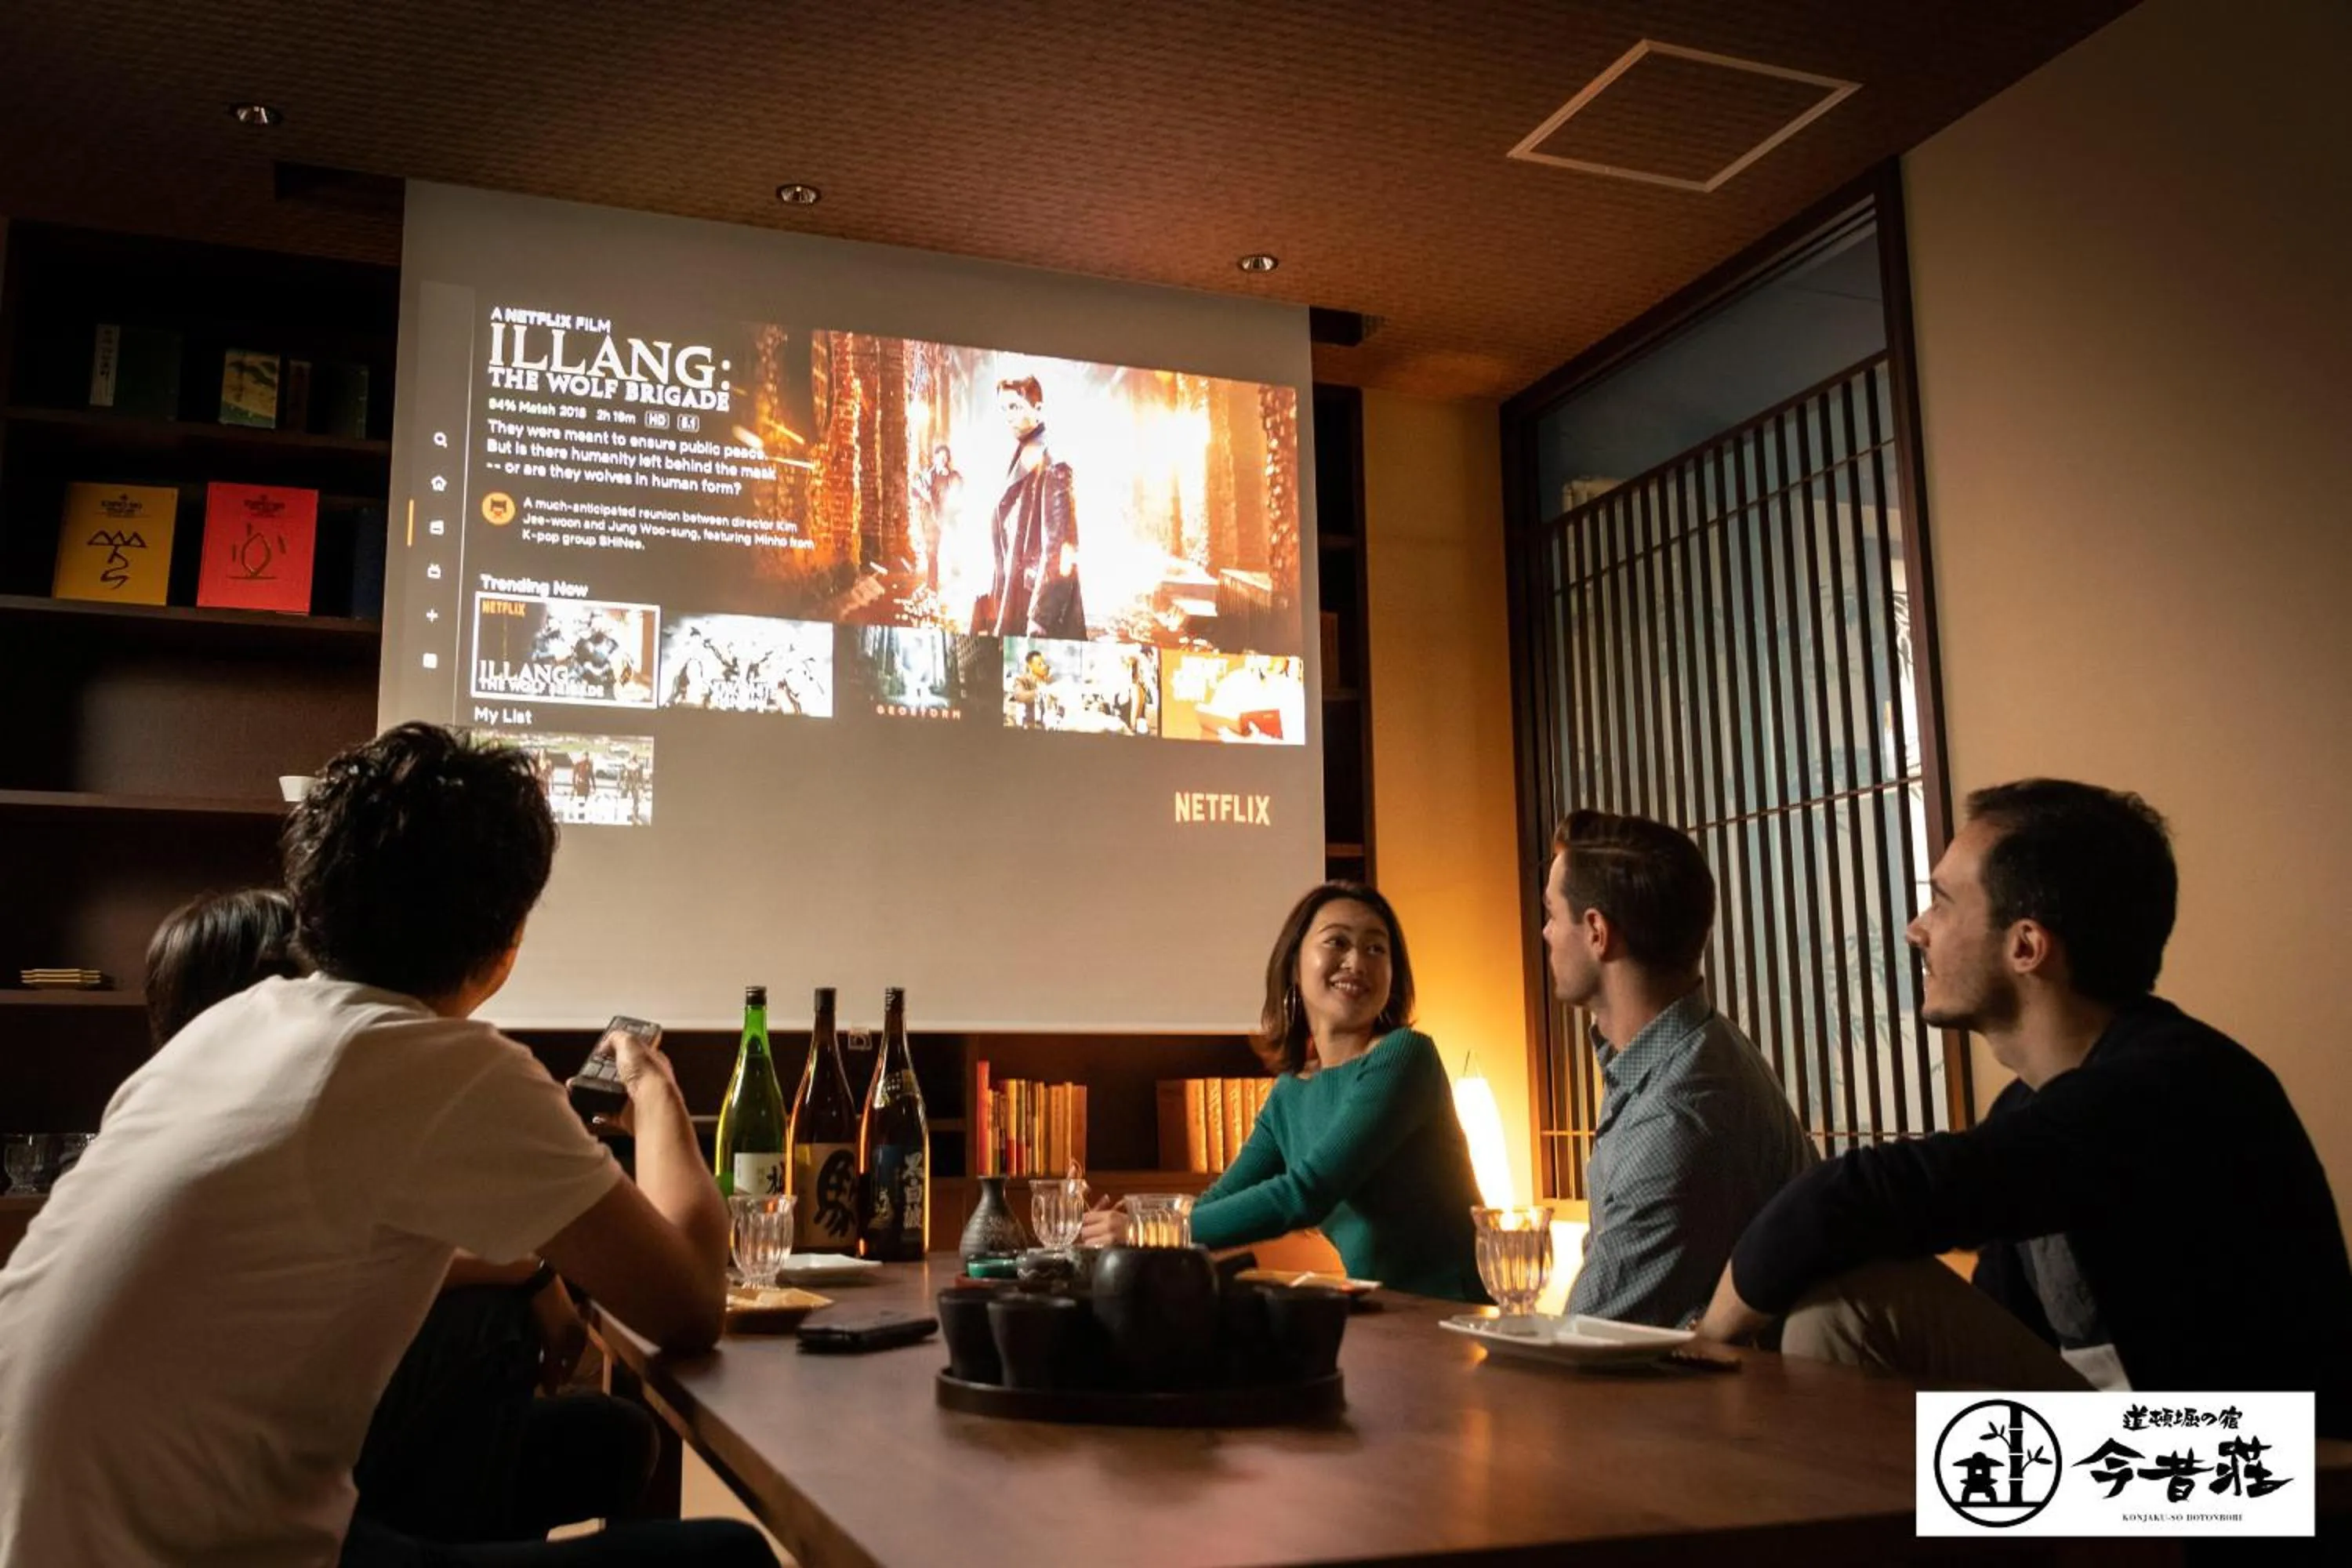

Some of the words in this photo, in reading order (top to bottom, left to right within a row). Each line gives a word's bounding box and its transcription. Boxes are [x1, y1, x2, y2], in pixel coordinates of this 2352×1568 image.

[491, 307, 502, 321] A
[504, 307, 572, 329] NETFLIX
[575, 316, 611, 333] FILM
[489, 322, 731, 390] ILLANG:
[488, 366, 539, 391] THE
[546, 372, 619, 399] WOLF
[625, 380, 730, 412] BRIGADE
[519, 401, 556, 416] Match
[559, 405, 587, 419] 2018
[596, 408, 611, 422] 2h
[649, 413, 666, 426] HD
[487, 419, 524, 438] They
[526, 425, 561, 440] were
[564, 429, 608, 445] meant
[612, 432, 626, 446] to
[630, 436, 677, 452] ensure
[680, 440, 720, 455] public
[487, 438, 511, 454] But
[515, 441, 527, 456] is
[531, 443, 568, 459] there
[571, 446, 637, 469] humanity
[639, 453, 662, 469] left
[665, 456, 712, 474] behind
[714, 462, 738, 476] the
[505, 463, 520, 474] or
[523, 464, 546, 477] are
[550, 464, 582, 483] they
[584, 469, 633, 485] wolves
[635, 473, 648, 486] in
[652, 474, 699, 492] human
[702, 479, 742, 495] form?
[523, 496, 532, 509] A
[535, 499, 637, 517] much-anticipated
[639, 508, 680, 521] reunion
[683, 511, 729, 527] between
[731, 517, 774, 531] director
[776, 520, 797, 533] Kim
[522, 528, 560, 544] K-pop
[562, 533, 597, 547] group
[523, 513, 581, 528] Jee-woon
[583, 519, 605, 532] and
[608, 521, 637, 535] Jung
[640, 523, 702, 542] Woo-sung,
[703, 528, 751, 546] featuring
[754, 534, 787, 547] Minho
[789, 537, 815, 551] from
[480, 574, 550, 597] Trending
[554, 580, 589, 597] Now
[482, 600, 526, 617] NETFLIX
[474, 706, 499, 724] My
[503, 709, 532, 724] List
[877, 704, 961, 720] GEOSTORM
[1175, 792, 1271, 826] NETFLIX
